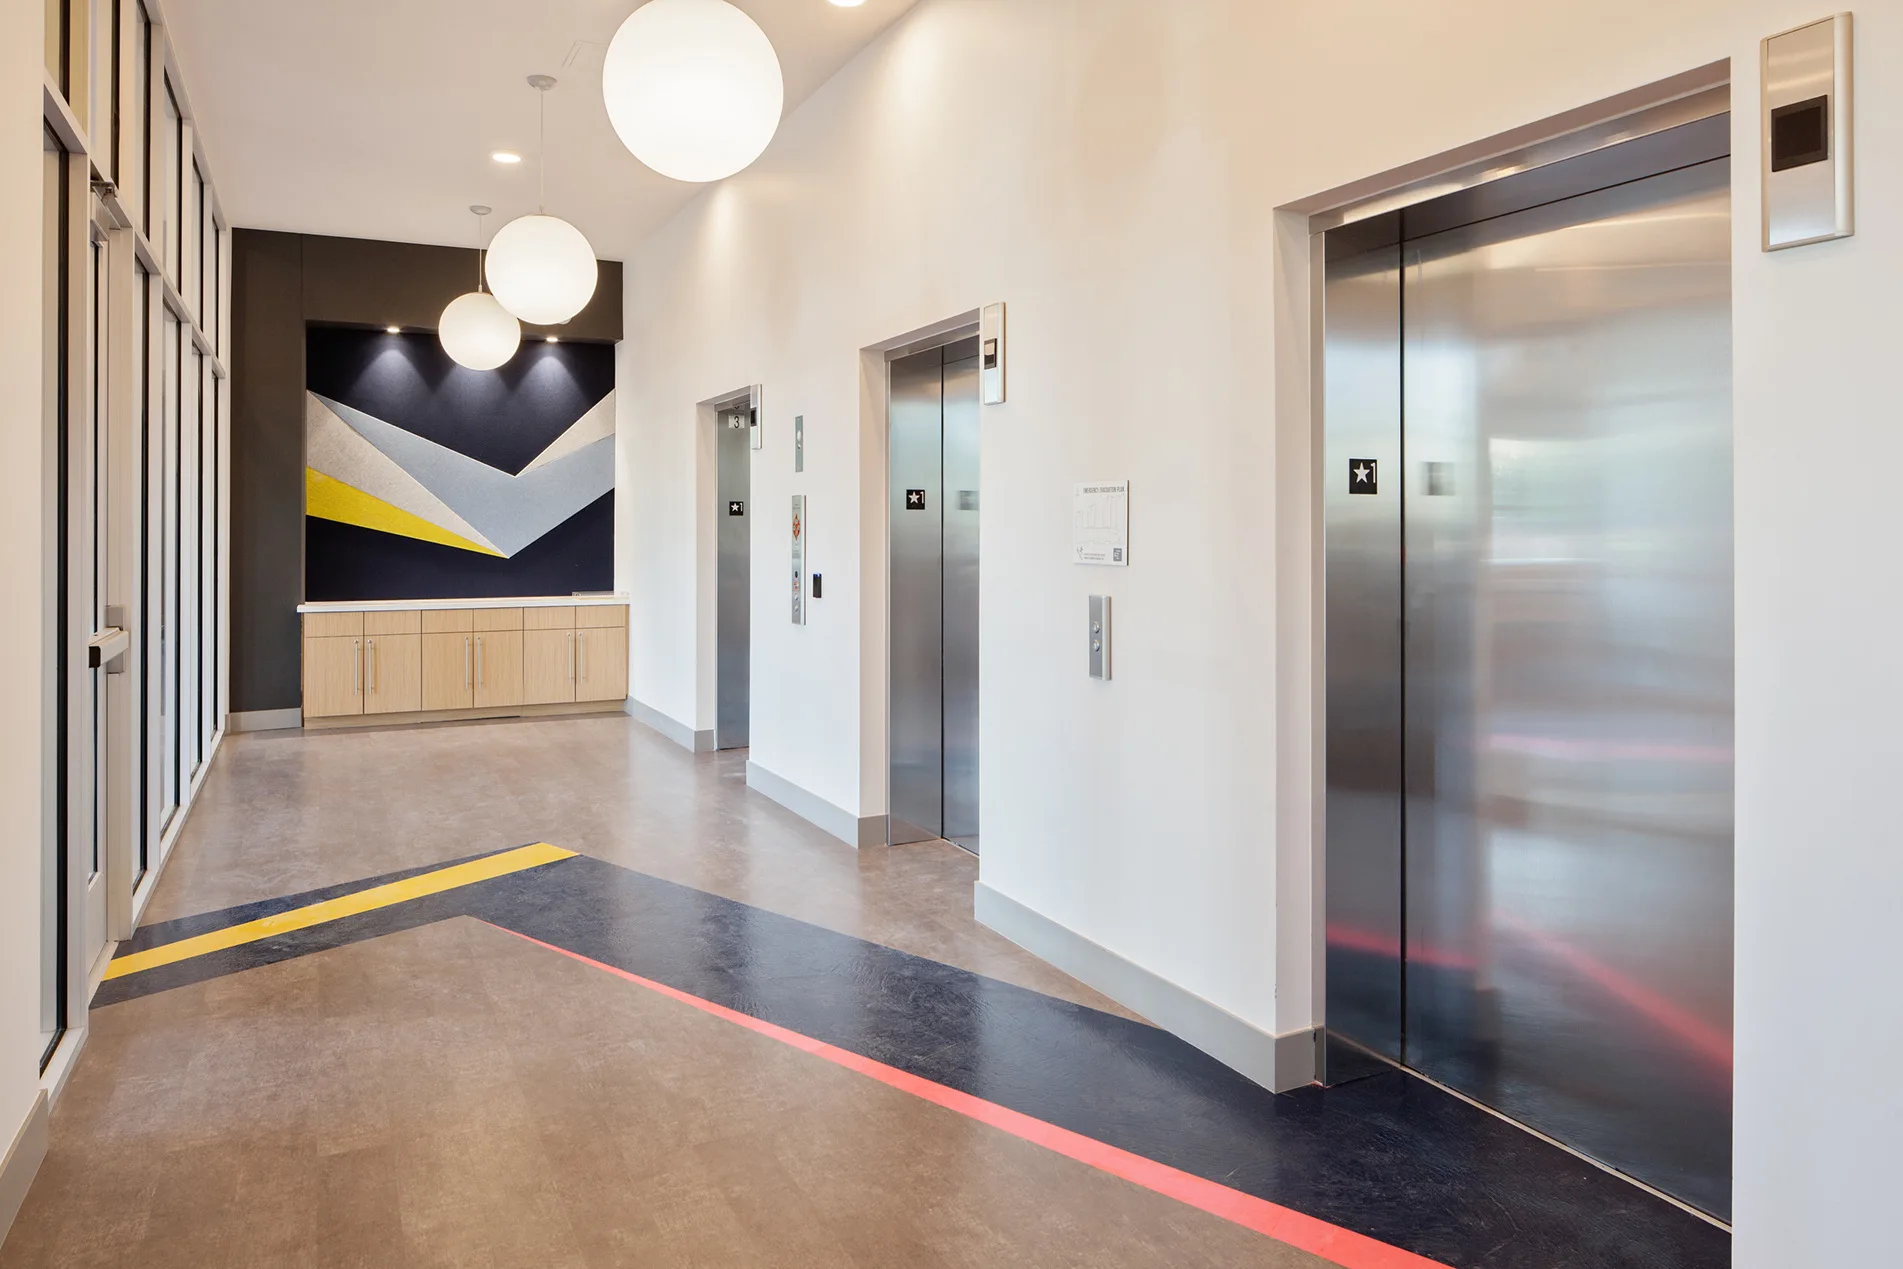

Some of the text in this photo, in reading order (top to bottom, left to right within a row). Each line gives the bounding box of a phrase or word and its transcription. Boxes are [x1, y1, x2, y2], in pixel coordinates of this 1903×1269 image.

[734, 415, 740, 429] 3
[1370, 462, 1376, 484] 1
[920, 491, 924, 504] 1
